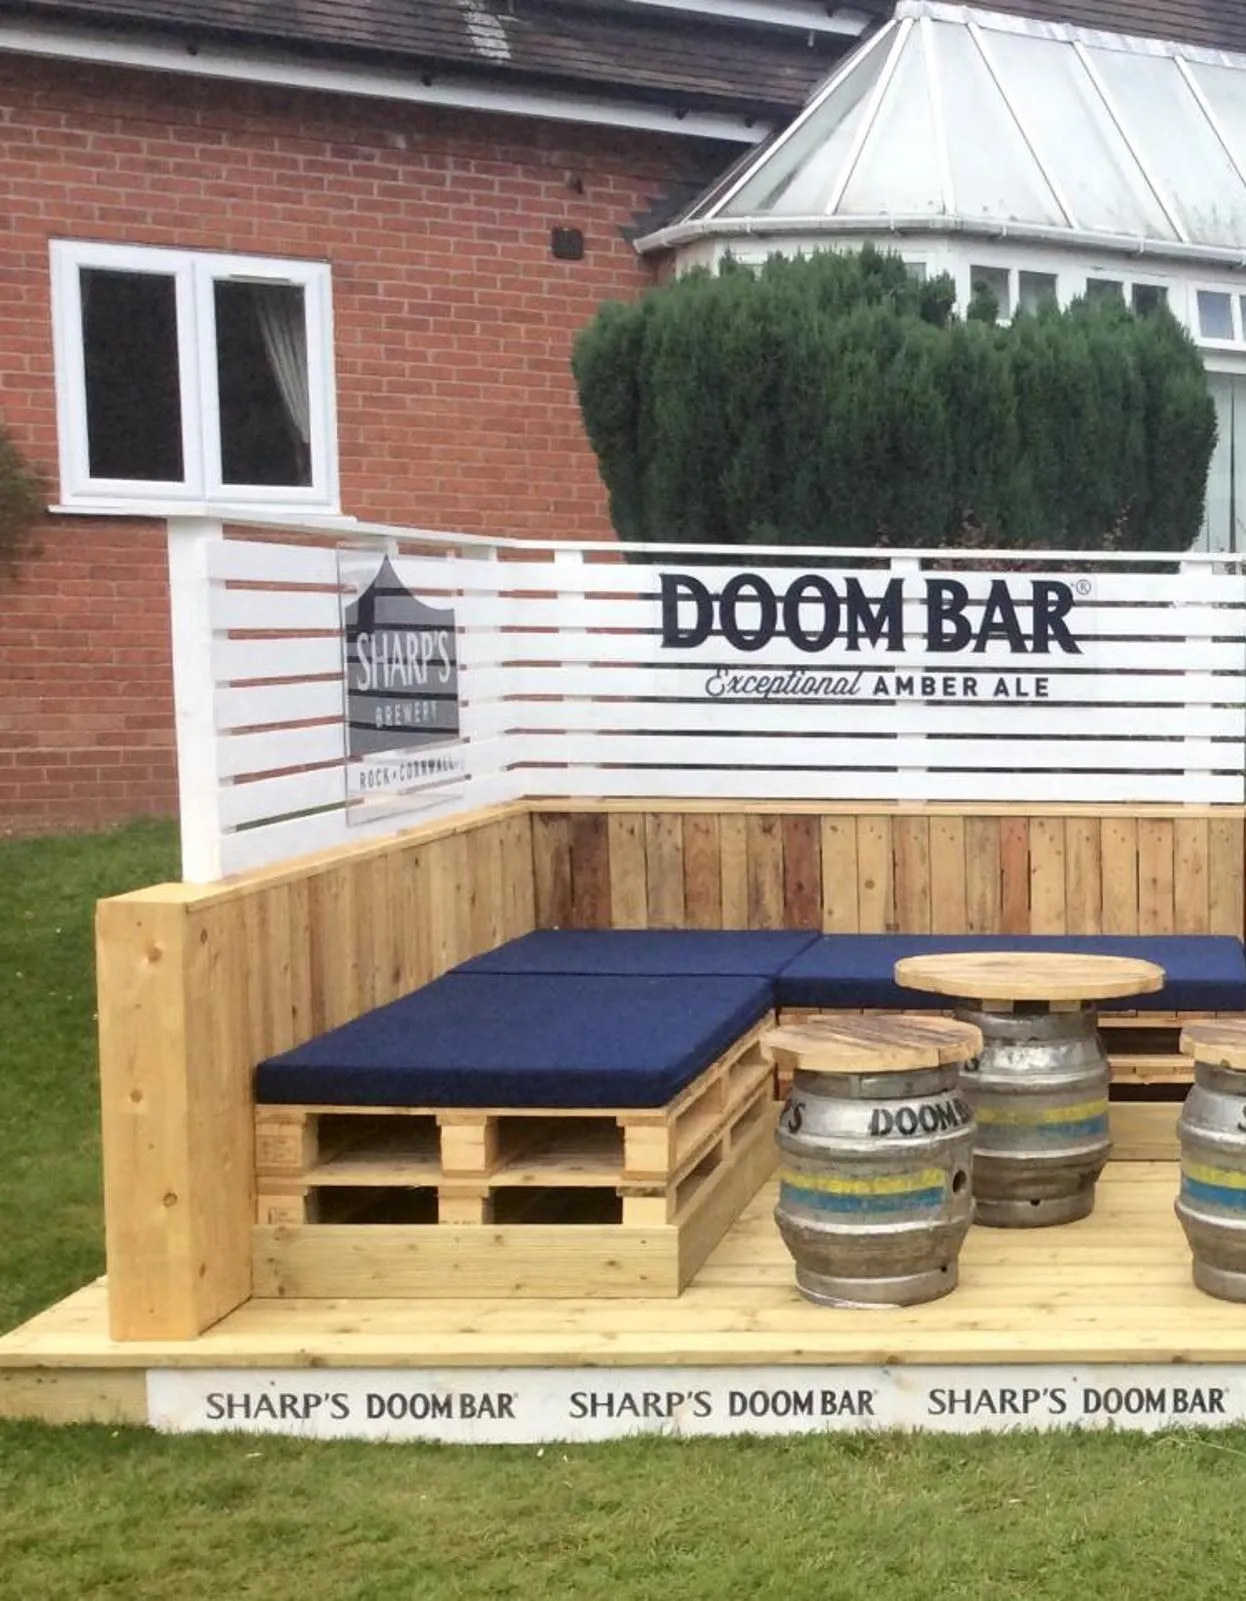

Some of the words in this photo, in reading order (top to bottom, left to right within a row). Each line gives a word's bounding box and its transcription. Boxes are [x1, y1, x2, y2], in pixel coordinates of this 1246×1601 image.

[659, 572, 906, 653] DOOM
[356, 630, 450, 692] SHARP'S
[705, 667, 864, 700] Exceptional
[873, 676, 978, 697] AMBER
[993, 676, 1049, 697] ALE
[360, 767, 391, 789] ROCK
[868, 1100, 960, 1137] DOOM
[206, 1392, 350, 1420] SHARP'S
[366, 1392, 453, 1420] DOOM
[568, 1390, 712, 1419] SHARP'S
[728, 1390, 814, 1417] DOOM
[927, 1387, 1067, 1415] SHARP'S
[1083, 1387, 1167, 1414] DOOM
